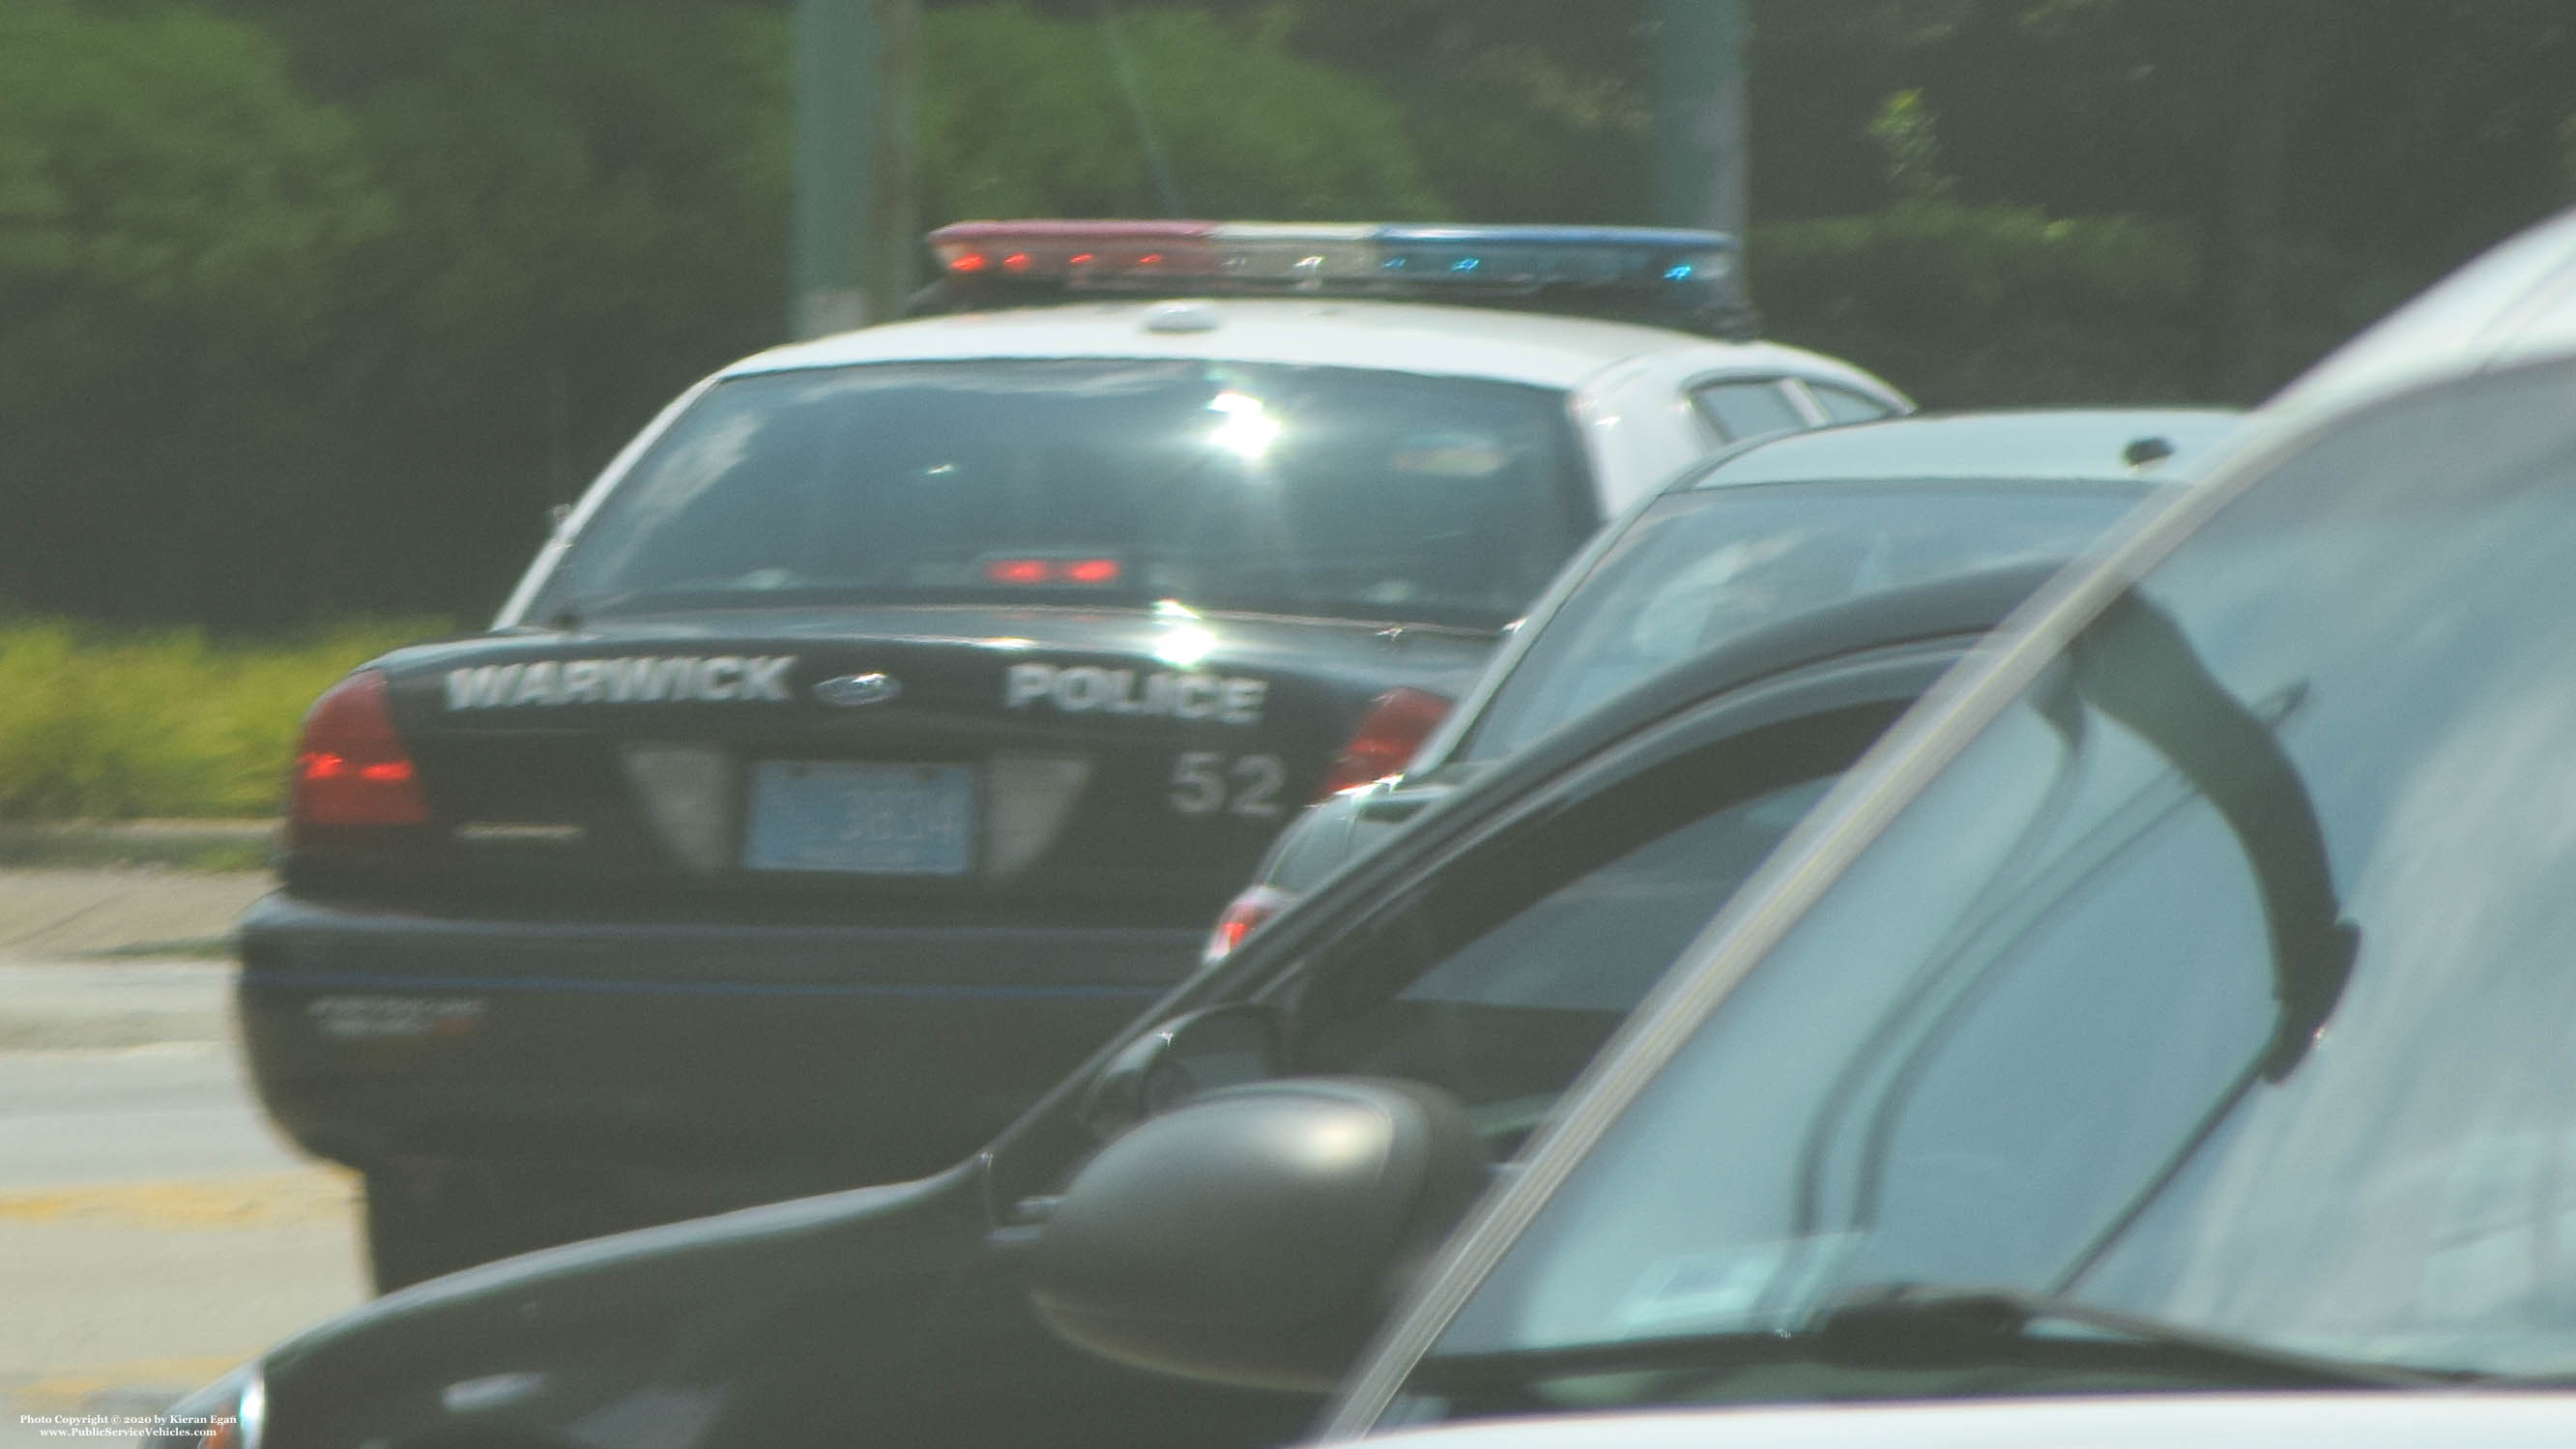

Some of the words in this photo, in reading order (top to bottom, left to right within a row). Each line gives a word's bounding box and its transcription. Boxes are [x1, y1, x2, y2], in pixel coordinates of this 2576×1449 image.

[448, 655, 798, 711] WARWICK
[1007, 662, 1269, 723] POLICE
[1169, 751, 1287, 817] 52
